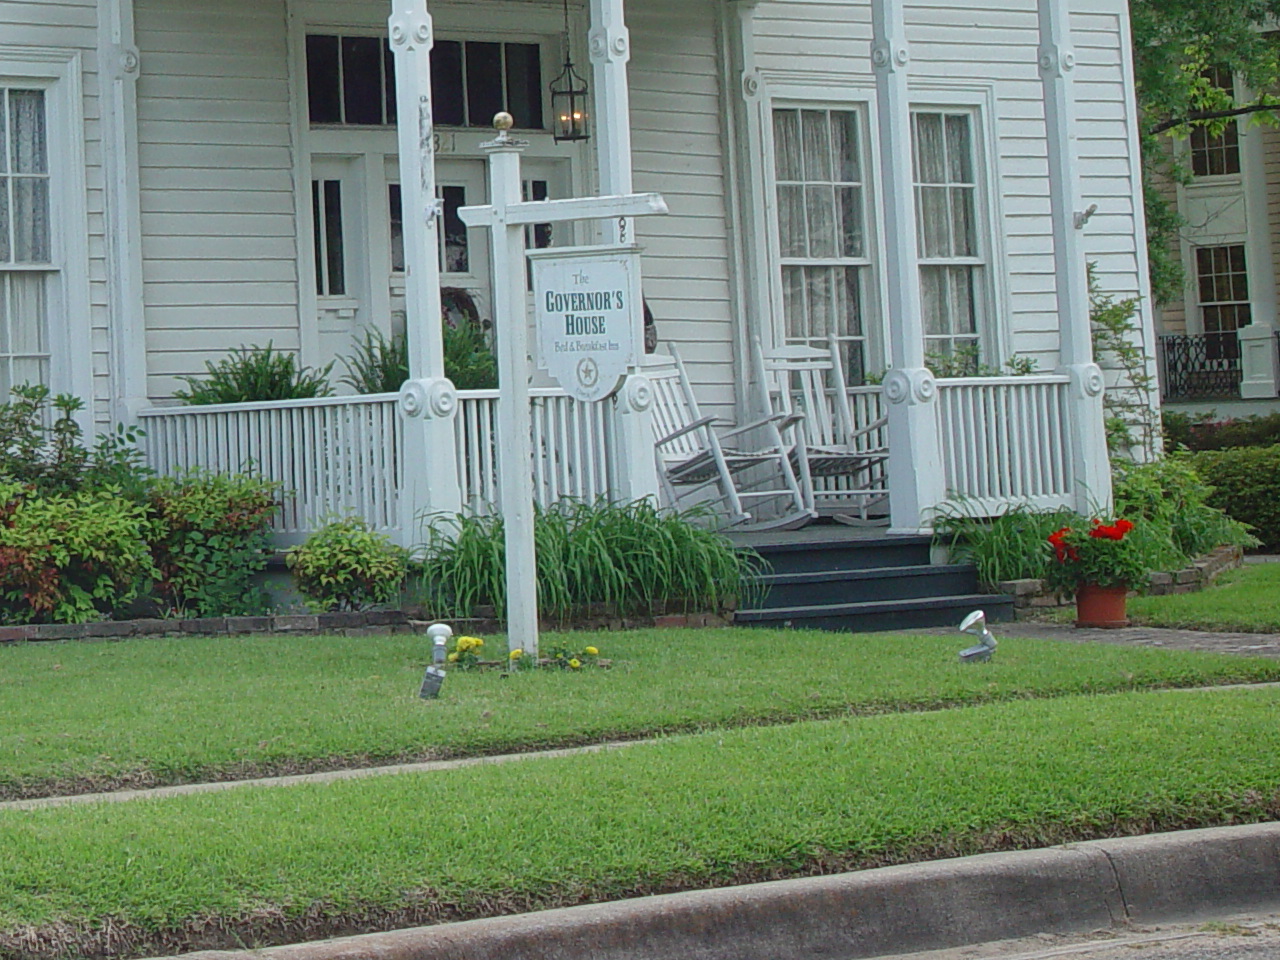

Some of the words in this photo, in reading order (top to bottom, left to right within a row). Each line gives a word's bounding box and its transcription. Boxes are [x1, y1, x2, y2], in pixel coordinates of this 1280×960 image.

[572, 269, 589, 285] The
[546, 291, 624, 312] GOVERNOR'S
[565, 314, 606, 336] HOUSE
[554, 341, 568, 352] Bed
[569, 341, 575, 352] &
[576, 340, 607, 352] Breakfast
[608, 339, 619, 351] Inn
